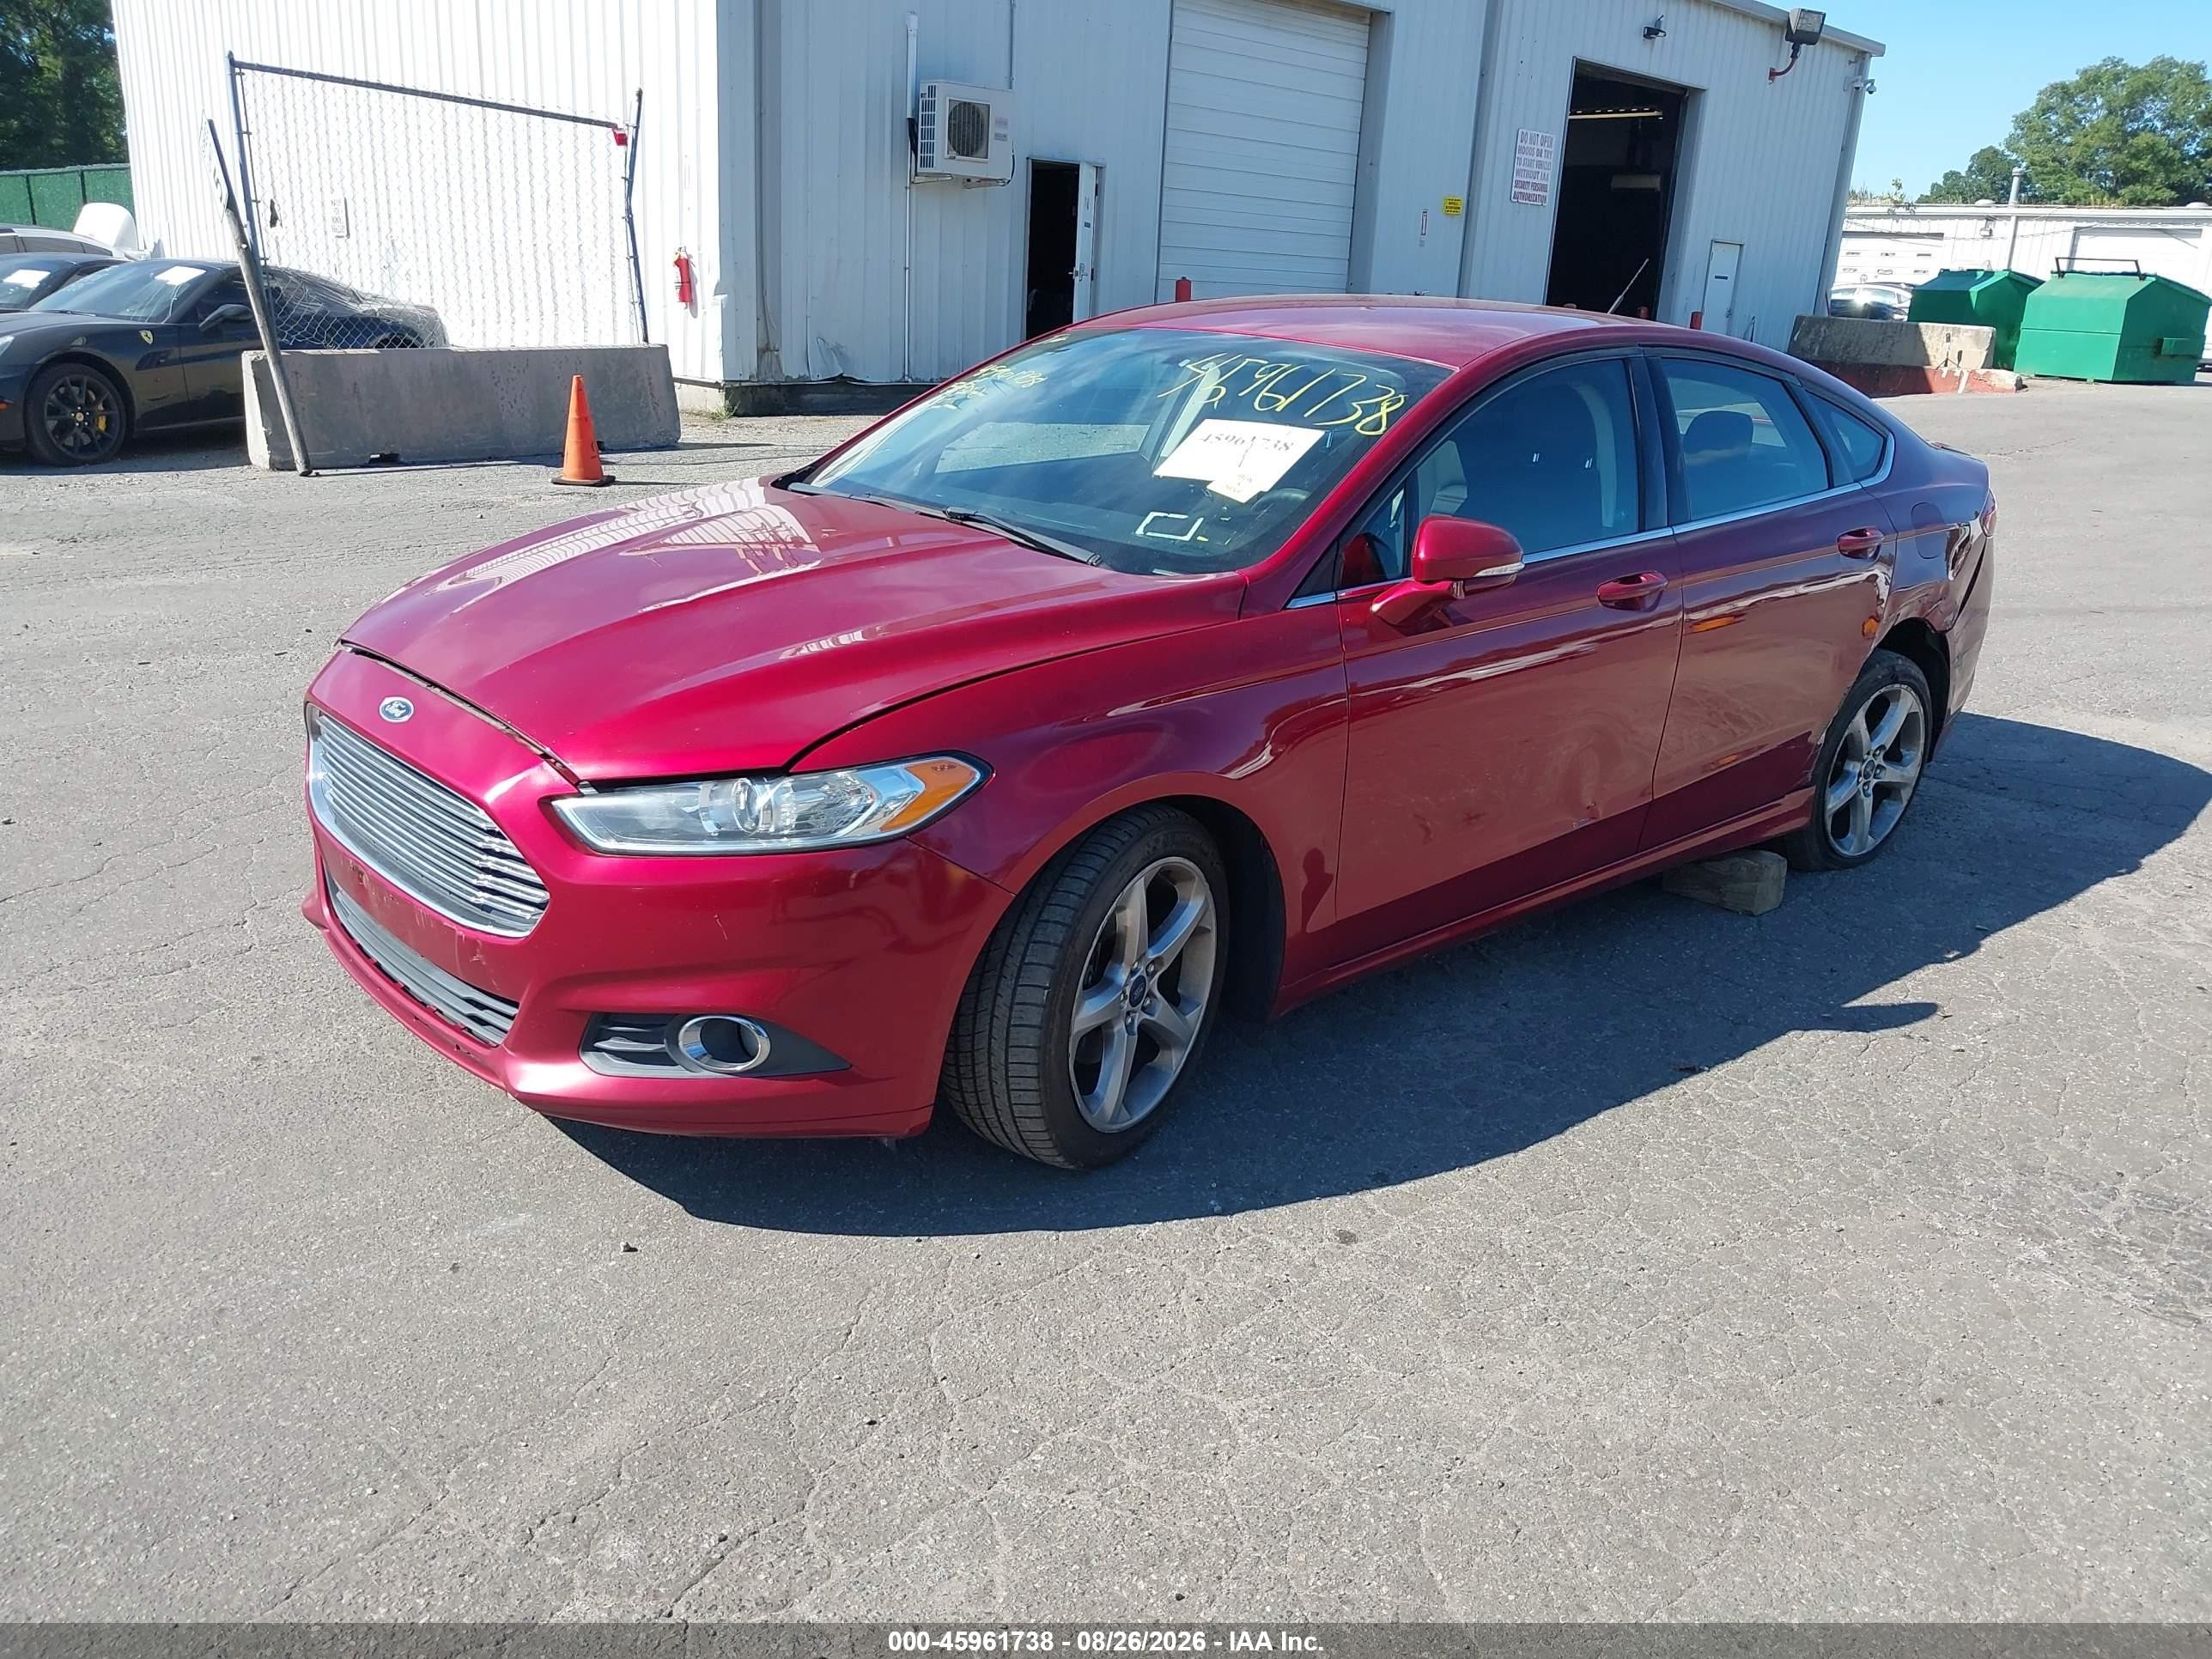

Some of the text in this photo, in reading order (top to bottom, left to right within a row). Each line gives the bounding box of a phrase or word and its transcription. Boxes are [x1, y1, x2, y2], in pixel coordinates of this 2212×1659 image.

[1520, 131, 1554, 149] DO NOT OPEN
[1517, 144, 1553, 160] HOODS OR TRY
[1516, 156, 1522, 167] TO
[1522, 157, 1535, 168] START
[1516, 168, 1540, 179] WITHOUT
[1514, 179, 1530, 190] SECURITY
[1512, 191, 1547, 204] AUTHORIZATION
[1157, 353, 1408, 436] 45961738
